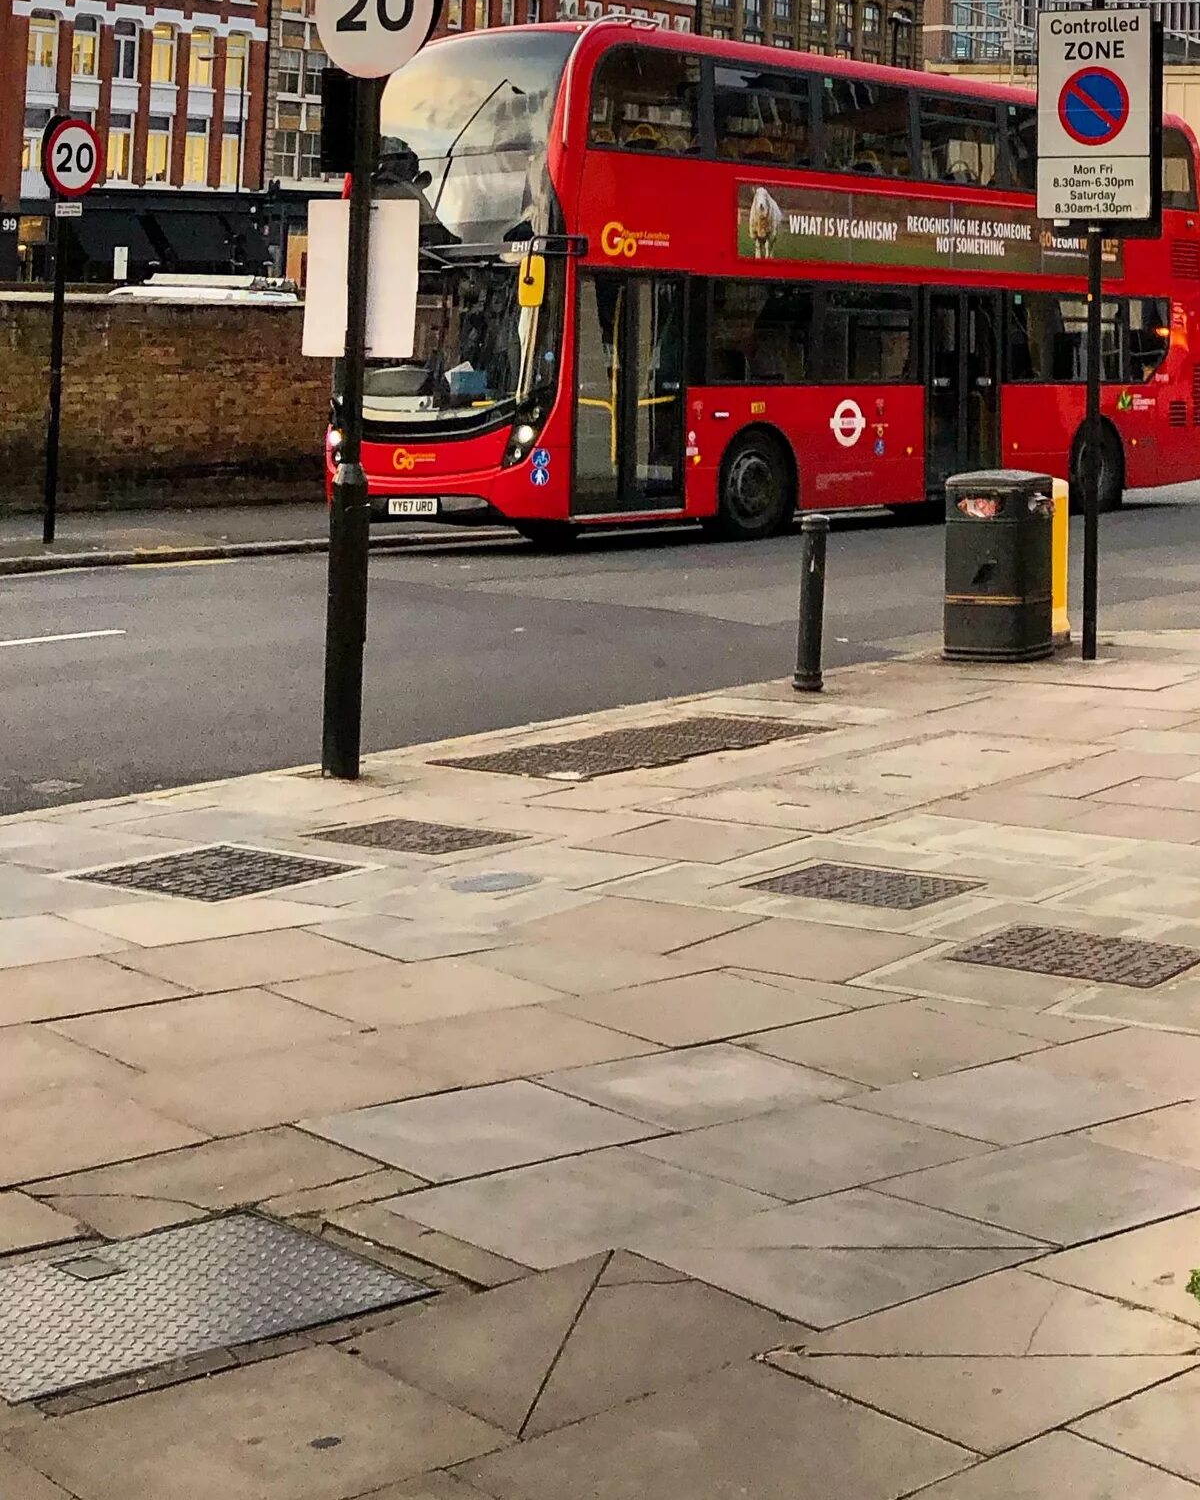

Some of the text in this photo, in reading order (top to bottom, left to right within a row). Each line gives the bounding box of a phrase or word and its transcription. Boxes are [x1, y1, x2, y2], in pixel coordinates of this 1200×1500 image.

[1050, 16, 1139, 35] Controlled
[1064, 40, 1125, 60] ZONE
[56, 143, 93, 173] 20
[1073, 164, 1113, 175] Mon Fri
[1053, 177, 1134, 189] 8.30am-6.30pm
[1070, 190, 1116, 202] Saturday
[2, 218, 17, 231] 99
[789, 214, 822, 236] WHAT
[824, 217, 835, 237] IS
[967, 219, 979, 236] ME
[981, 221, 992, 237] AS
[994, 222, 1031, 240] SOMEONE
[601, 221, 637, 258] Go
[936, 236, 1004, 256] NOT SOMETHING
[392, 501, 413, 512] YY67
